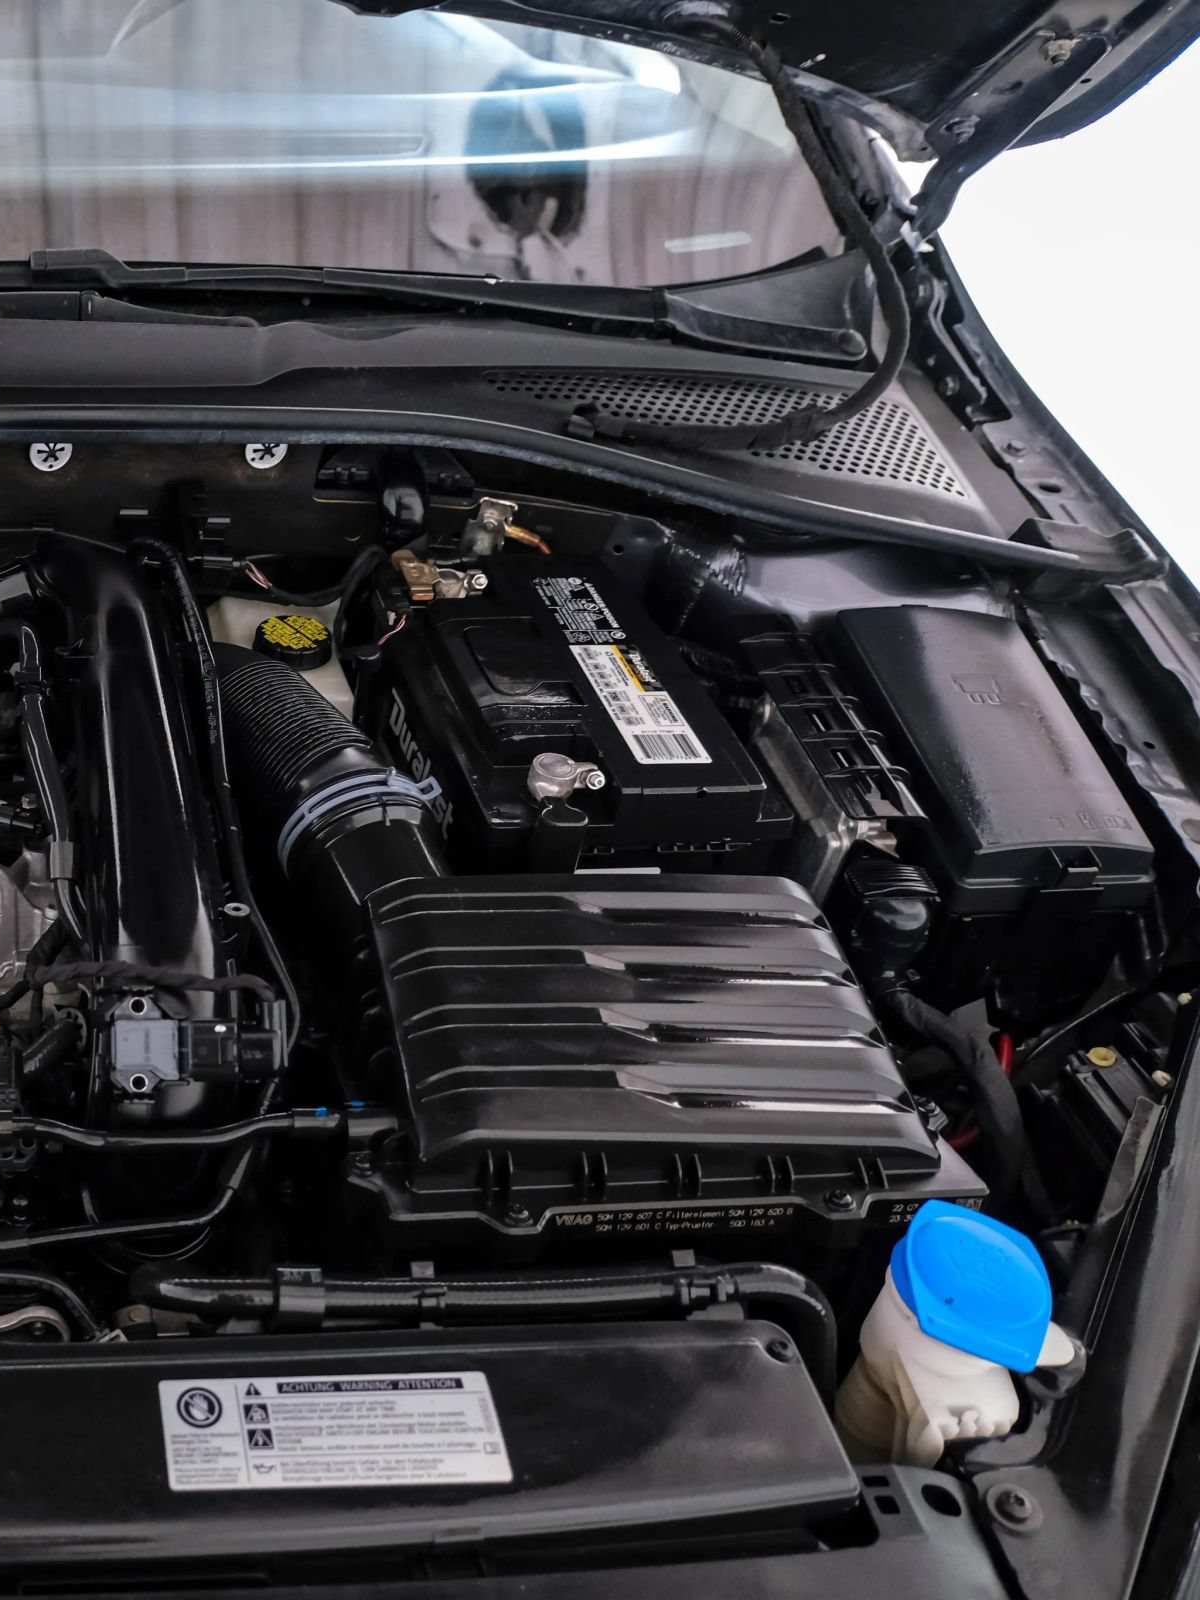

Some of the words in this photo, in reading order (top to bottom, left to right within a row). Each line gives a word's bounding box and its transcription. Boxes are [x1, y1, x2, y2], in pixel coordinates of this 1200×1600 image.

[389, 687, 453, 840] Duralst
[618, 1213, 633, 1221] 129
[636, 1212, 653, 1220] 607
[656, 1211, 663, 1219] C
[749, 1208, 764, 1216] 129
[767, 1208, 783, 1216] 620
[892, 1204, 904, 1212] 22
[617, 1223, 632, 1231] 129
[635, 1222, 650, 1230] 601
[654, 1222, 661, 1230] C
[281, 1382, 334, 1393] ACHTUNG
[339, 1380, 393, 1391] WARNING
[397, 1378, 456, 1389] ATTENTION
